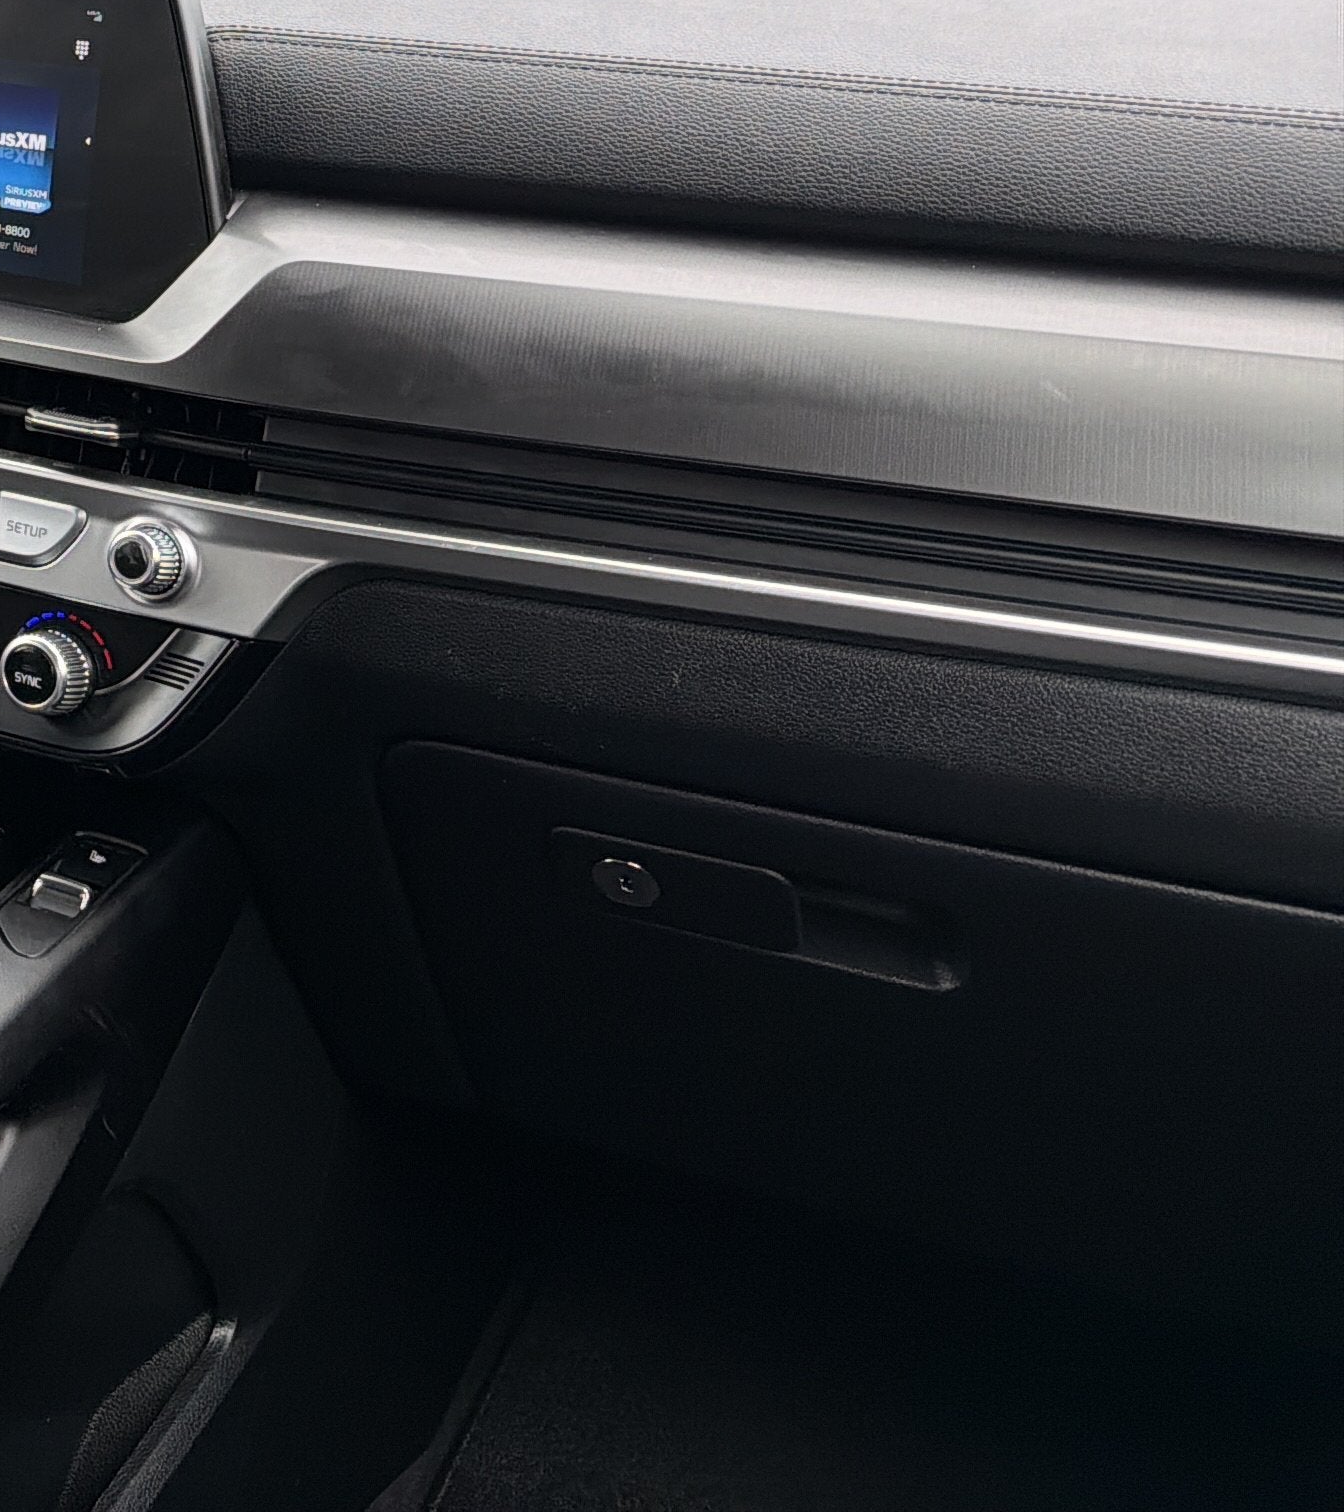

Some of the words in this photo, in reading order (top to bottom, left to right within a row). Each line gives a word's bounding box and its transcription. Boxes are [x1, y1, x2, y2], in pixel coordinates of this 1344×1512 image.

[5, 184, 48, 200] SIRIUSXM
[13, 241, 38, 256] Now!
[6, 520, 49, 538] SETUP
[14, 672, 43, 689] SYNC
